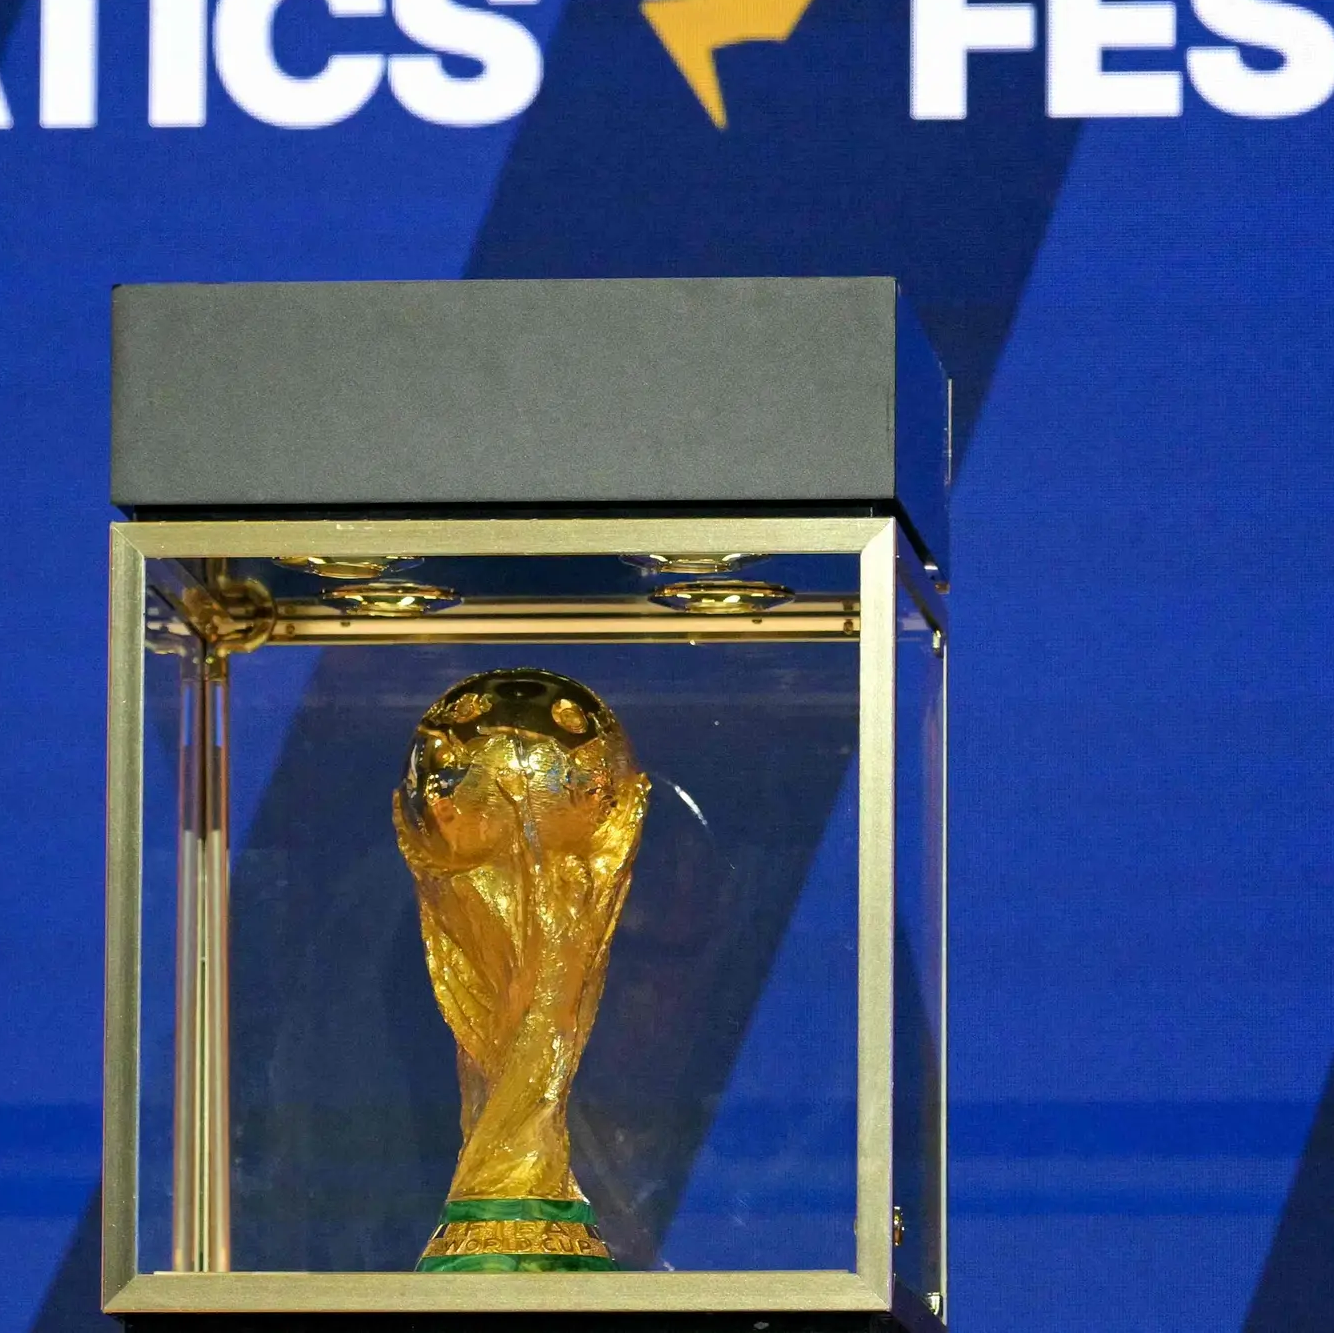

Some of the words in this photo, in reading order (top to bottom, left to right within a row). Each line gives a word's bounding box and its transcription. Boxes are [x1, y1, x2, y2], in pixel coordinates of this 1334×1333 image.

[463, 1220, 571, 1238] FIFA
[444, 1237, 532, 1254] WORLD
[540, 1237, 593, 1255] CUP
